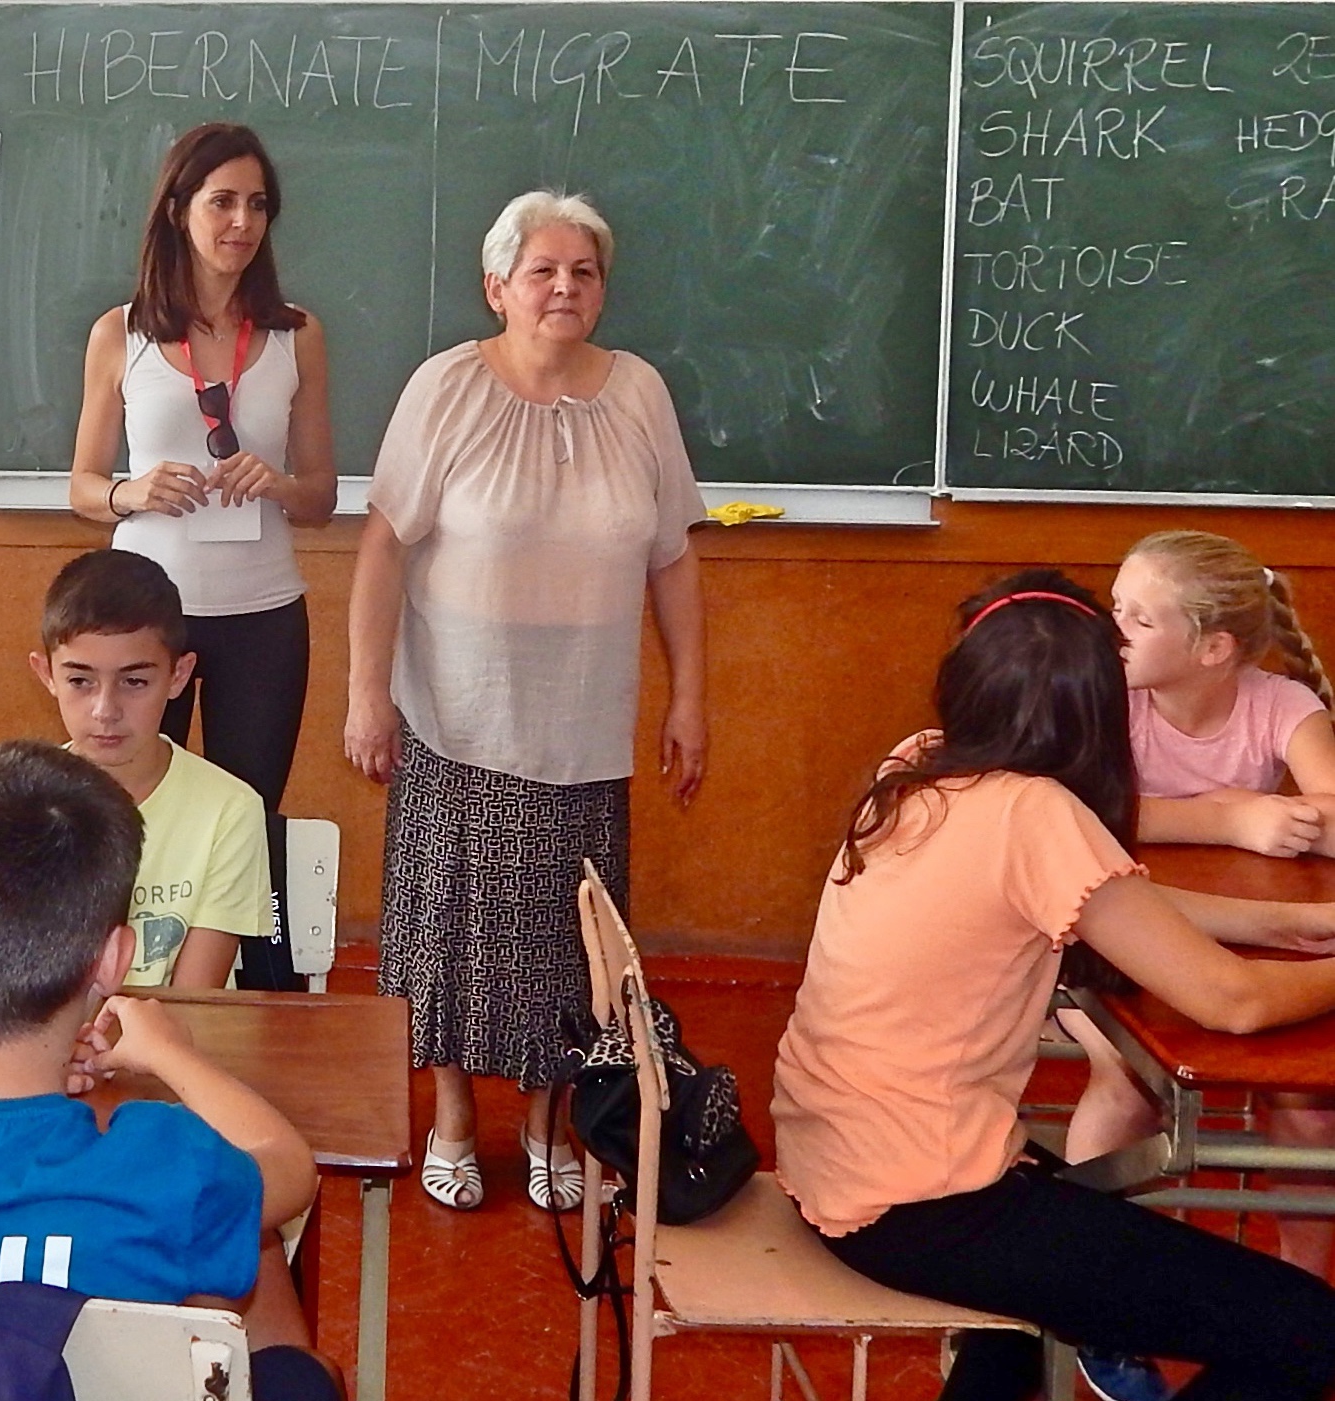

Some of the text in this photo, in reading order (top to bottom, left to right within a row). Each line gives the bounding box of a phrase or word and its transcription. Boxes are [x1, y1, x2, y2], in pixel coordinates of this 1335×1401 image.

[23, 27, 413, 108] HIBERNATE
[476, 28, 849, 137] MIGRATE
[973, 35, 1234, 100] SQUIRREL
[979, 106, 1167, 160] SHARK
[968, 173, 1065, 227] BAT
[963, 241, 1188, 292] TORTOISE
[968, 308, 1093, 356] DUCK
[971, 369, 1119, 421] WHALE
[973, 426, 1125, 470] LIZARD
[133, 880, 193, 905] ORED
